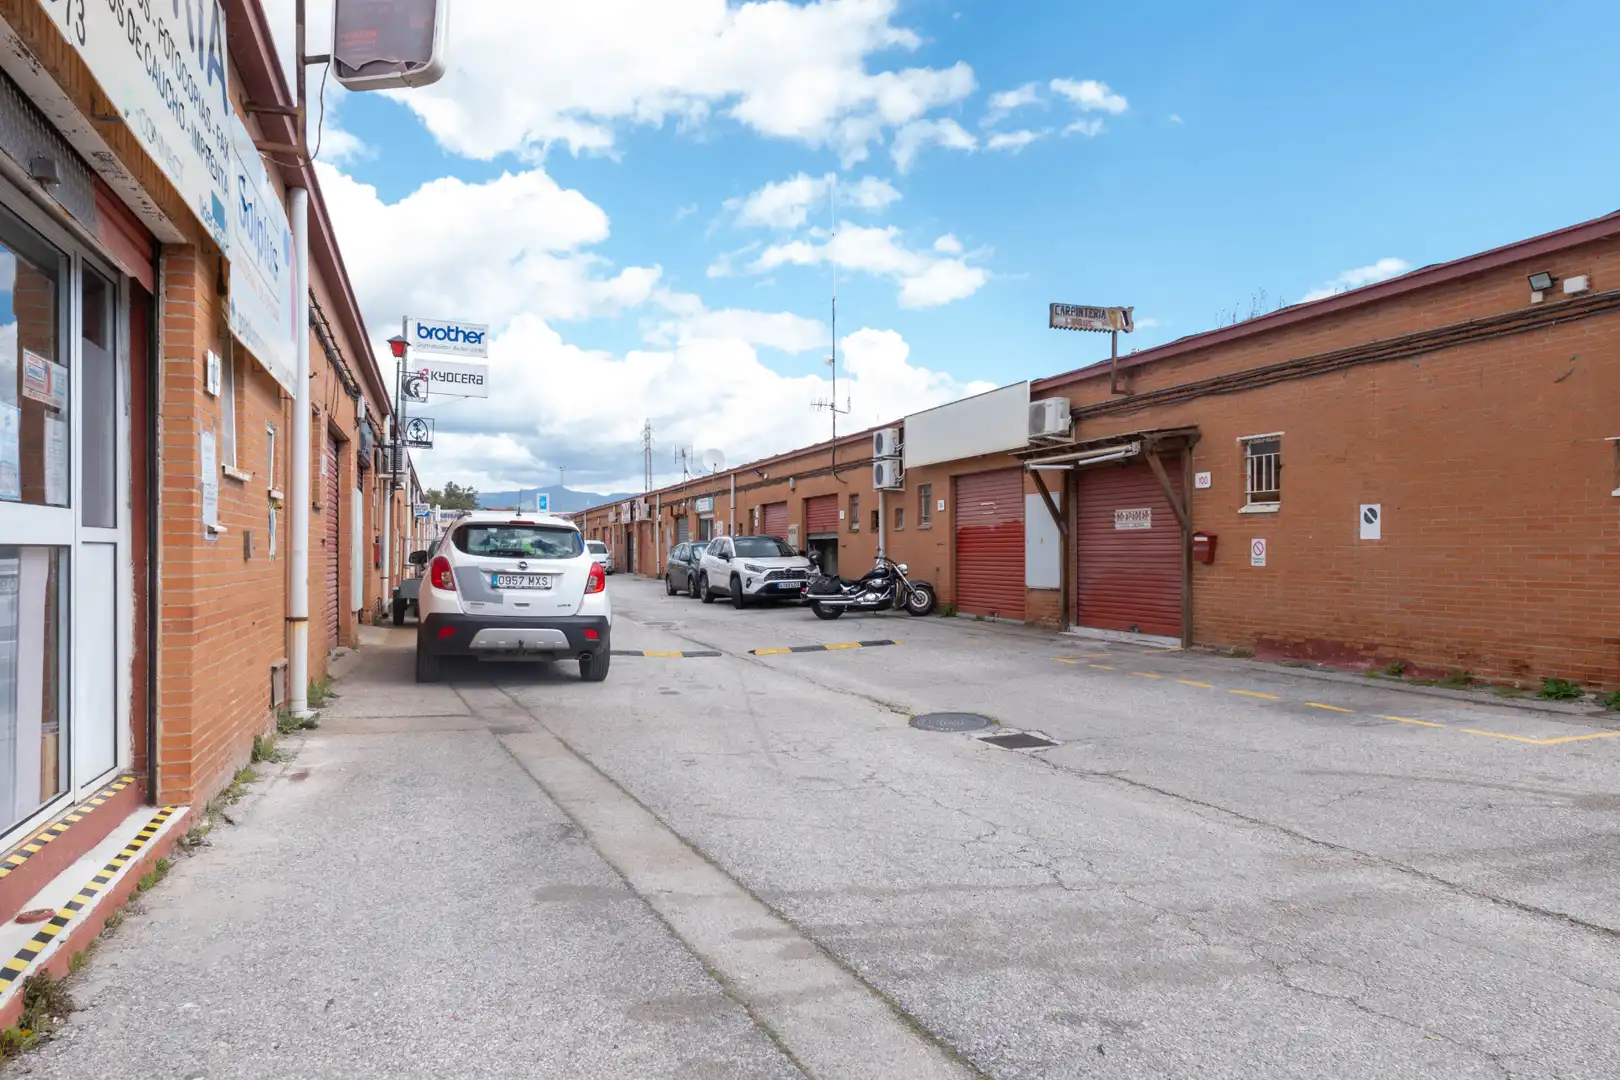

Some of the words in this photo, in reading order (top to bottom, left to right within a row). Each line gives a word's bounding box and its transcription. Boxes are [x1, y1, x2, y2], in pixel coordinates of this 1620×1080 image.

[127, 8, 142, 61] DE
[144, 42, 185, 131] CAUCHO
[191, 118, 230, 200] IMPRENTA
[158, 17, 211, 134] FOTOCOPIAS
[217, 123, 230, 164] FAX
[417, 322, 485, 344] brother
[498, 575, 525, 586] 0957
[528, 575, 549, 586] MXS
